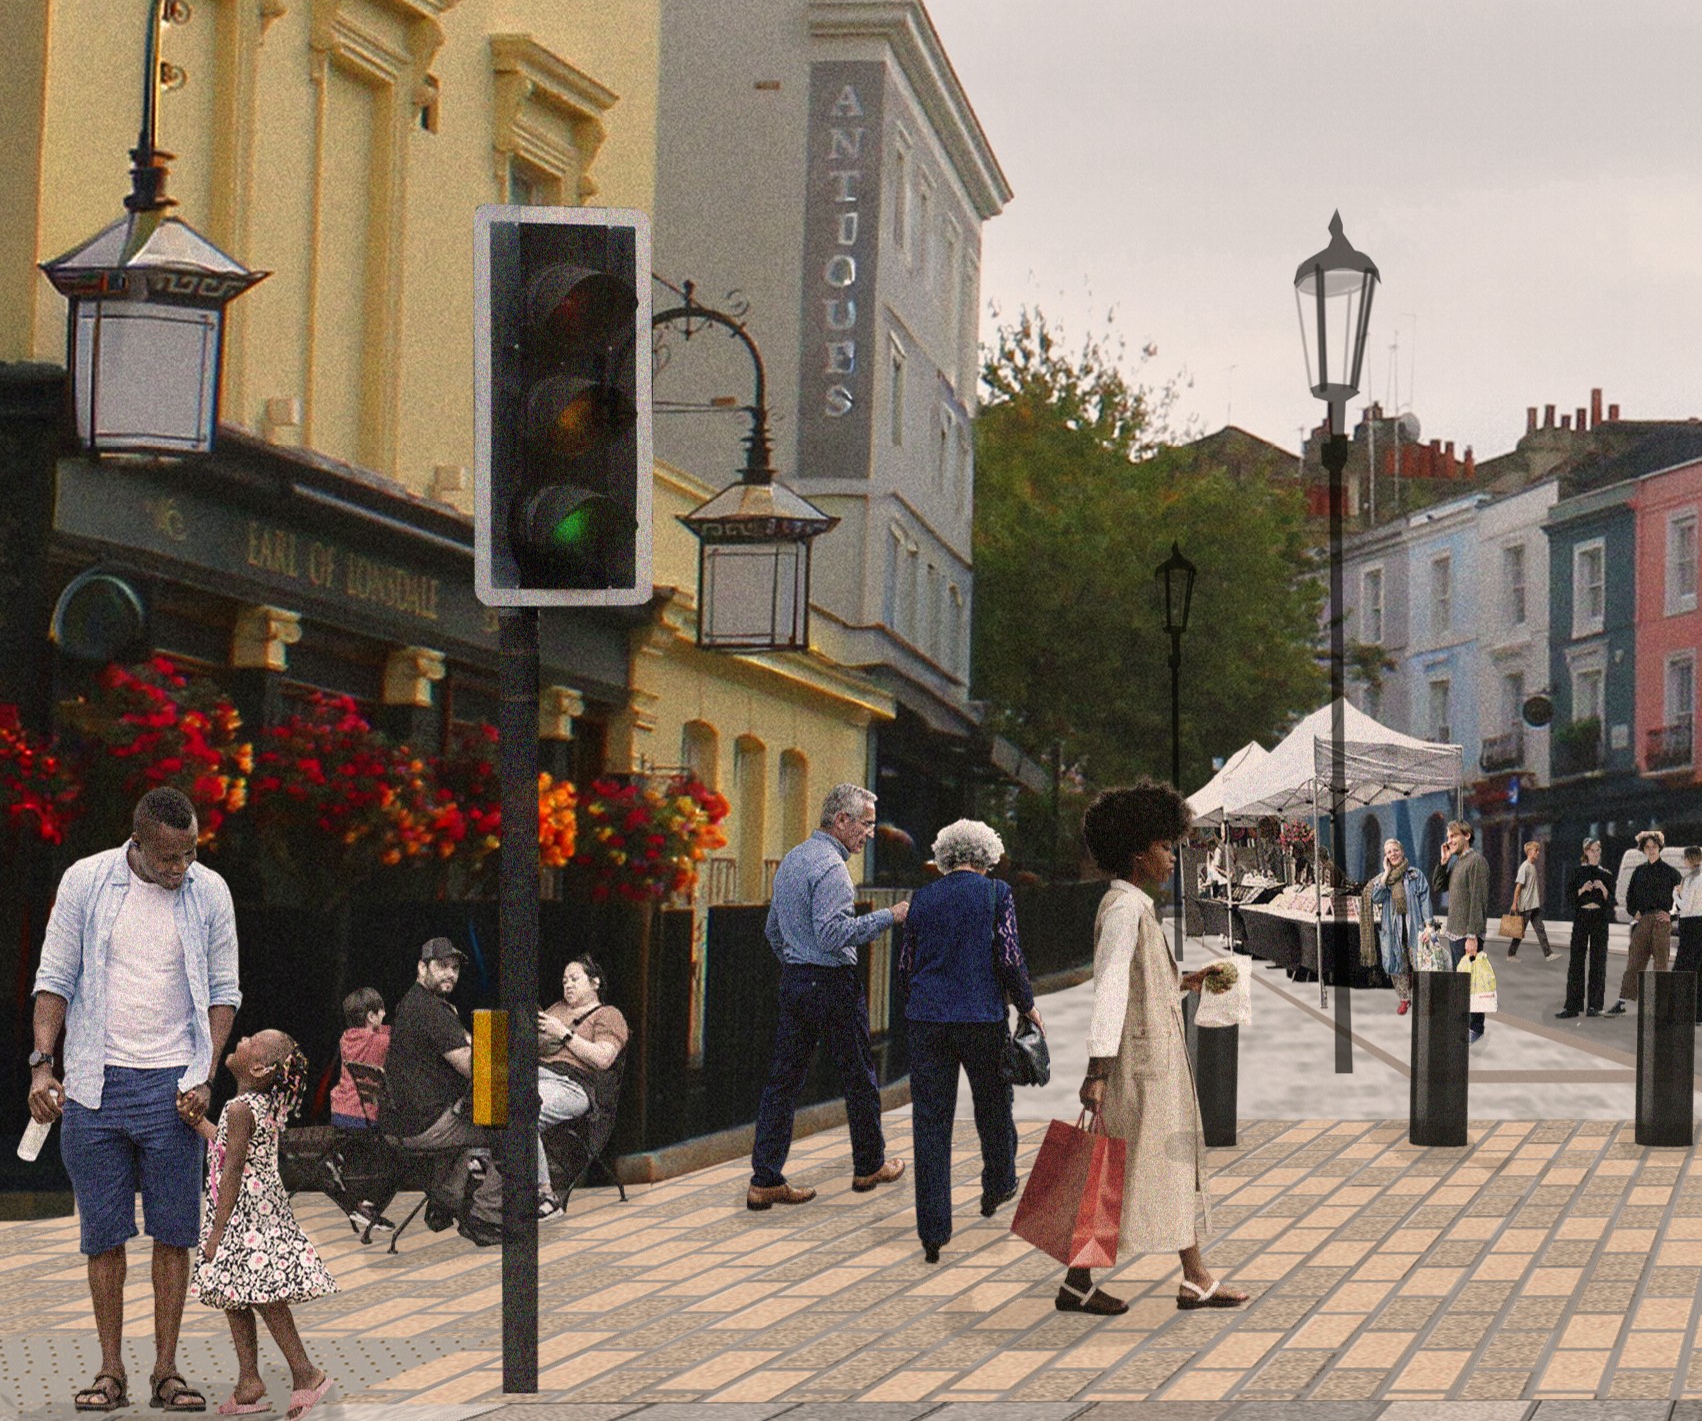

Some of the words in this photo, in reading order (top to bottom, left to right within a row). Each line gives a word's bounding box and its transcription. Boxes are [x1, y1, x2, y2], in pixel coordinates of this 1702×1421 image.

[823, 83, 866, 419] ANTIQUES
[247, 520, 298, 579] EARL
[309, 541, 337, 589] OF
[346, 551, 439, 621] LONSDALE
